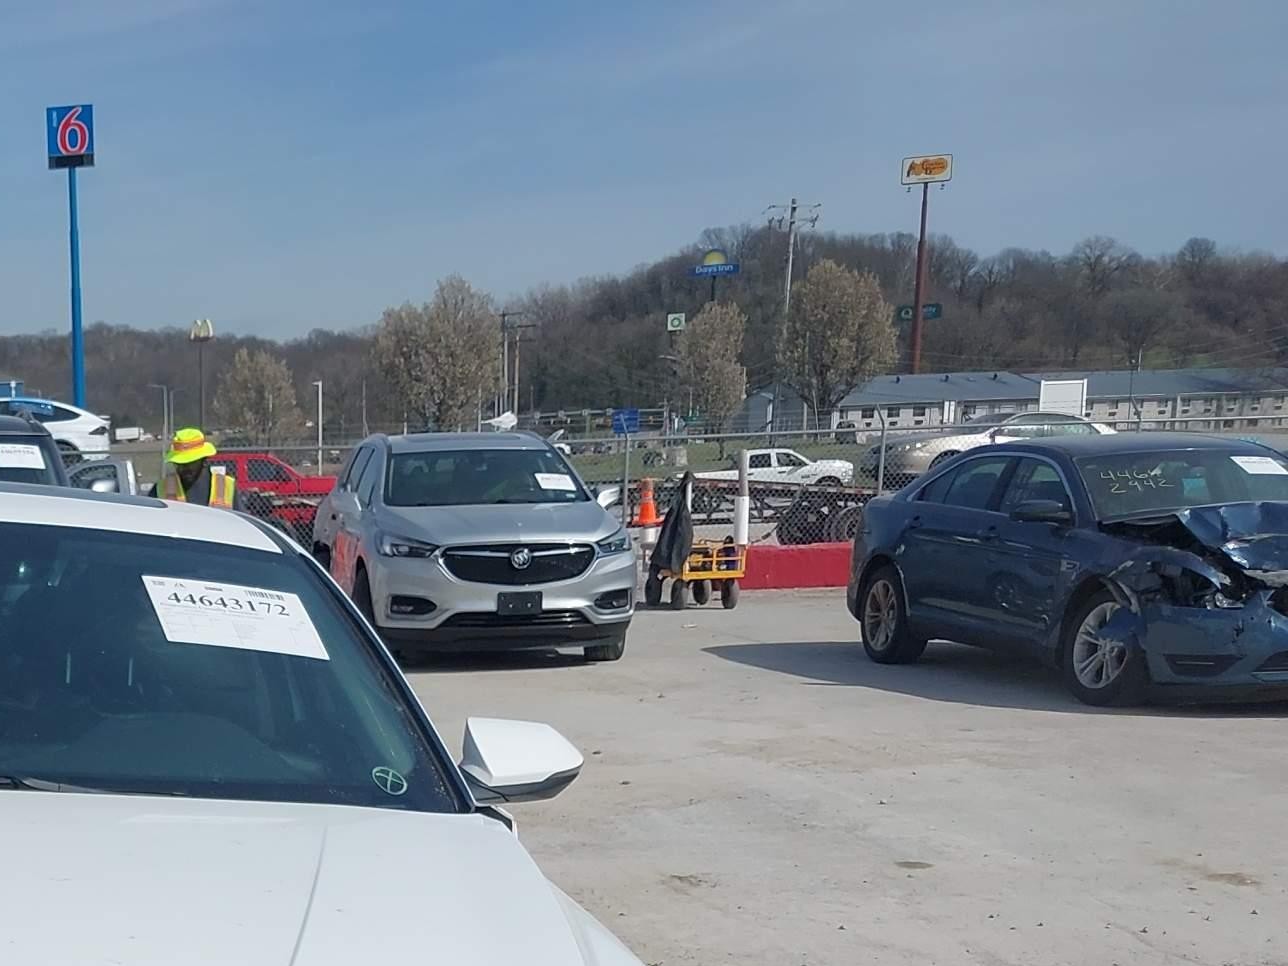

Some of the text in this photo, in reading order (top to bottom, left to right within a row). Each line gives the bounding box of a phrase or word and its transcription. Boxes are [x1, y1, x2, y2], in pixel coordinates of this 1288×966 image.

[57, 106, 89, 156] 6
[1110, 478, 1176, 494] 2942
[167, 591, 290, 617] 44643172
